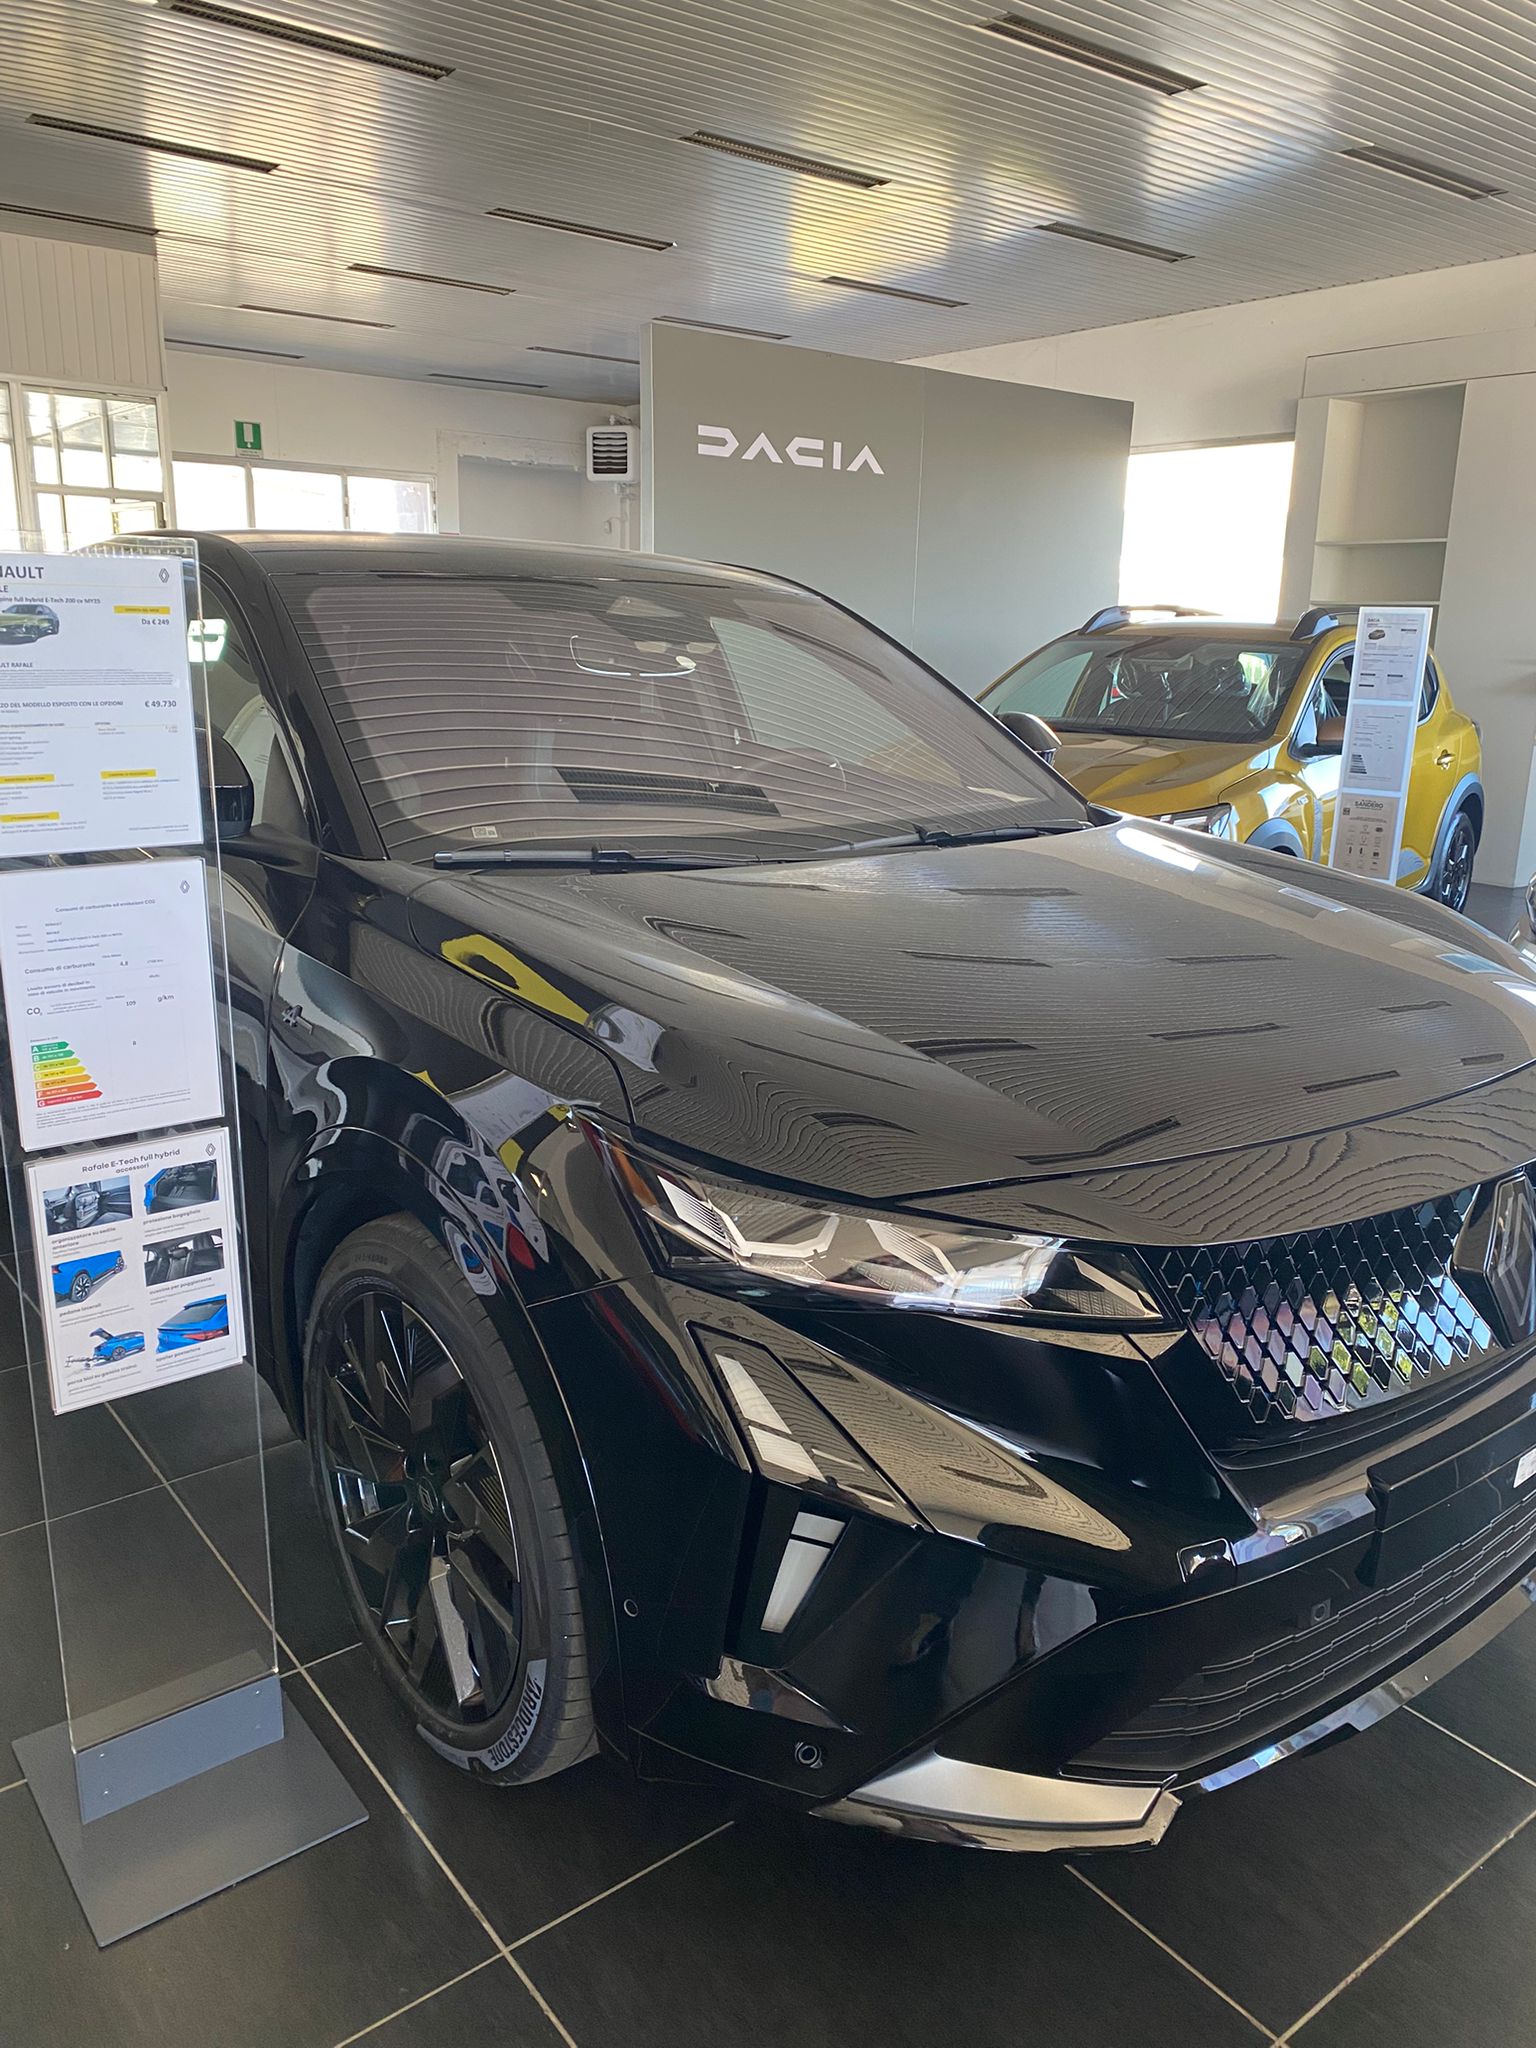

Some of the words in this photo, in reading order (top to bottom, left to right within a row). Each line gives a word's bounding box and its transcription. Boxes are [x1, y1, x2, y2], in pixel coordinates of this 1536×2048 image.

[697, 424, 885, 475] DACIA
[0, 566, 44, 580] AULT
[81, 1162, 110, 1173] Rafale
[110, 1156, 139, 1168] E-Tech
[140, 1153, 154, 1163] full
[154, 1148, 181, 1162] hybrid
